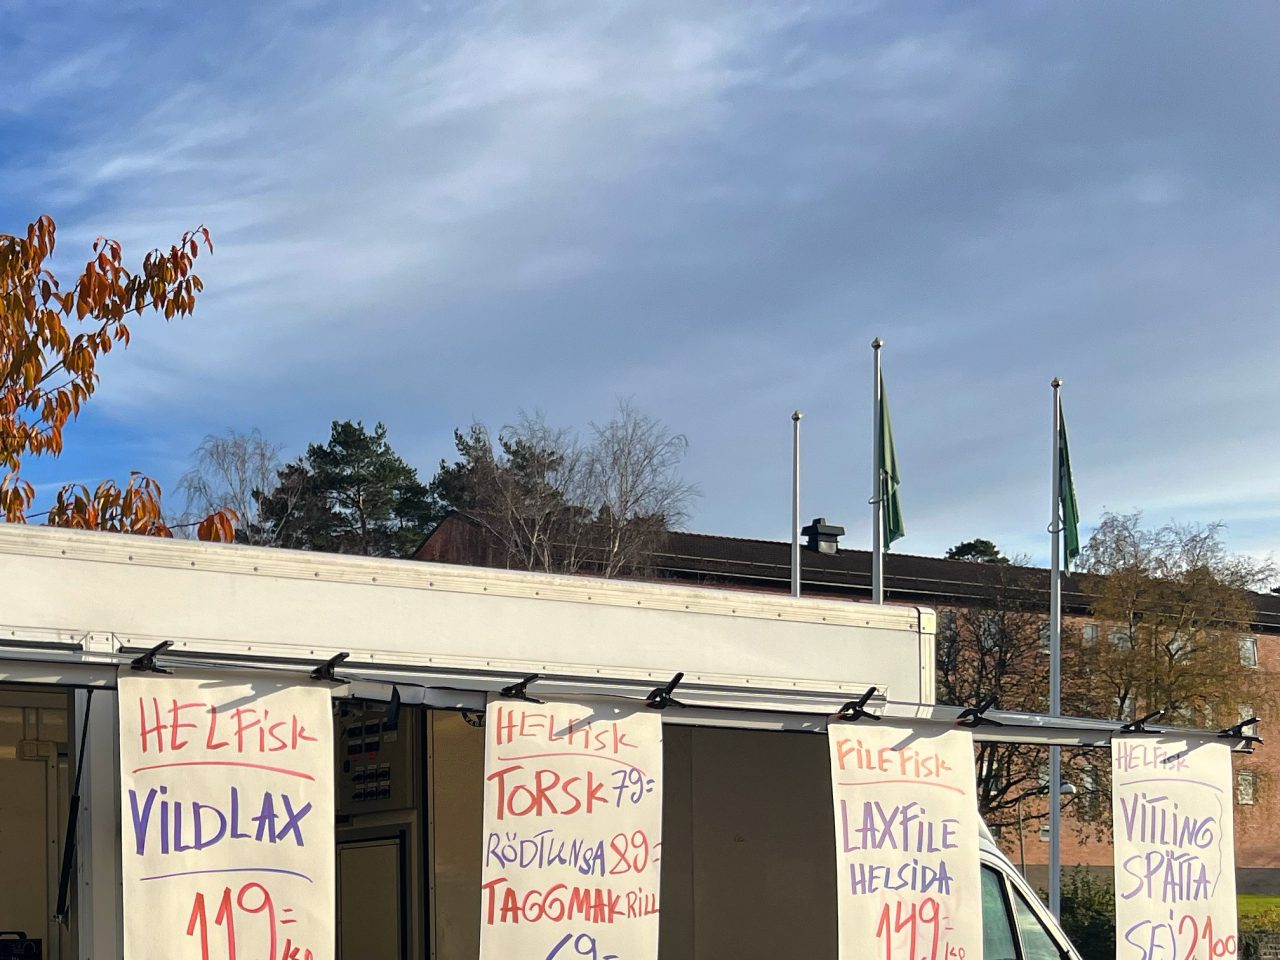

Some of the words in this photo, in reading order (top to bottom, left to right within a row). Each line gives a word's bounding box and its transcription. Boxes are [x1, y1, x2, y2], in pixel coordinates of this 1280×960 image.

[487, 765, 608, 820] TORSK
[129, 786, 312, 855] VILDLAX
[1120, 793, 1217, 849] VITLING
[850, 858, 953, 895] HELSIDA
